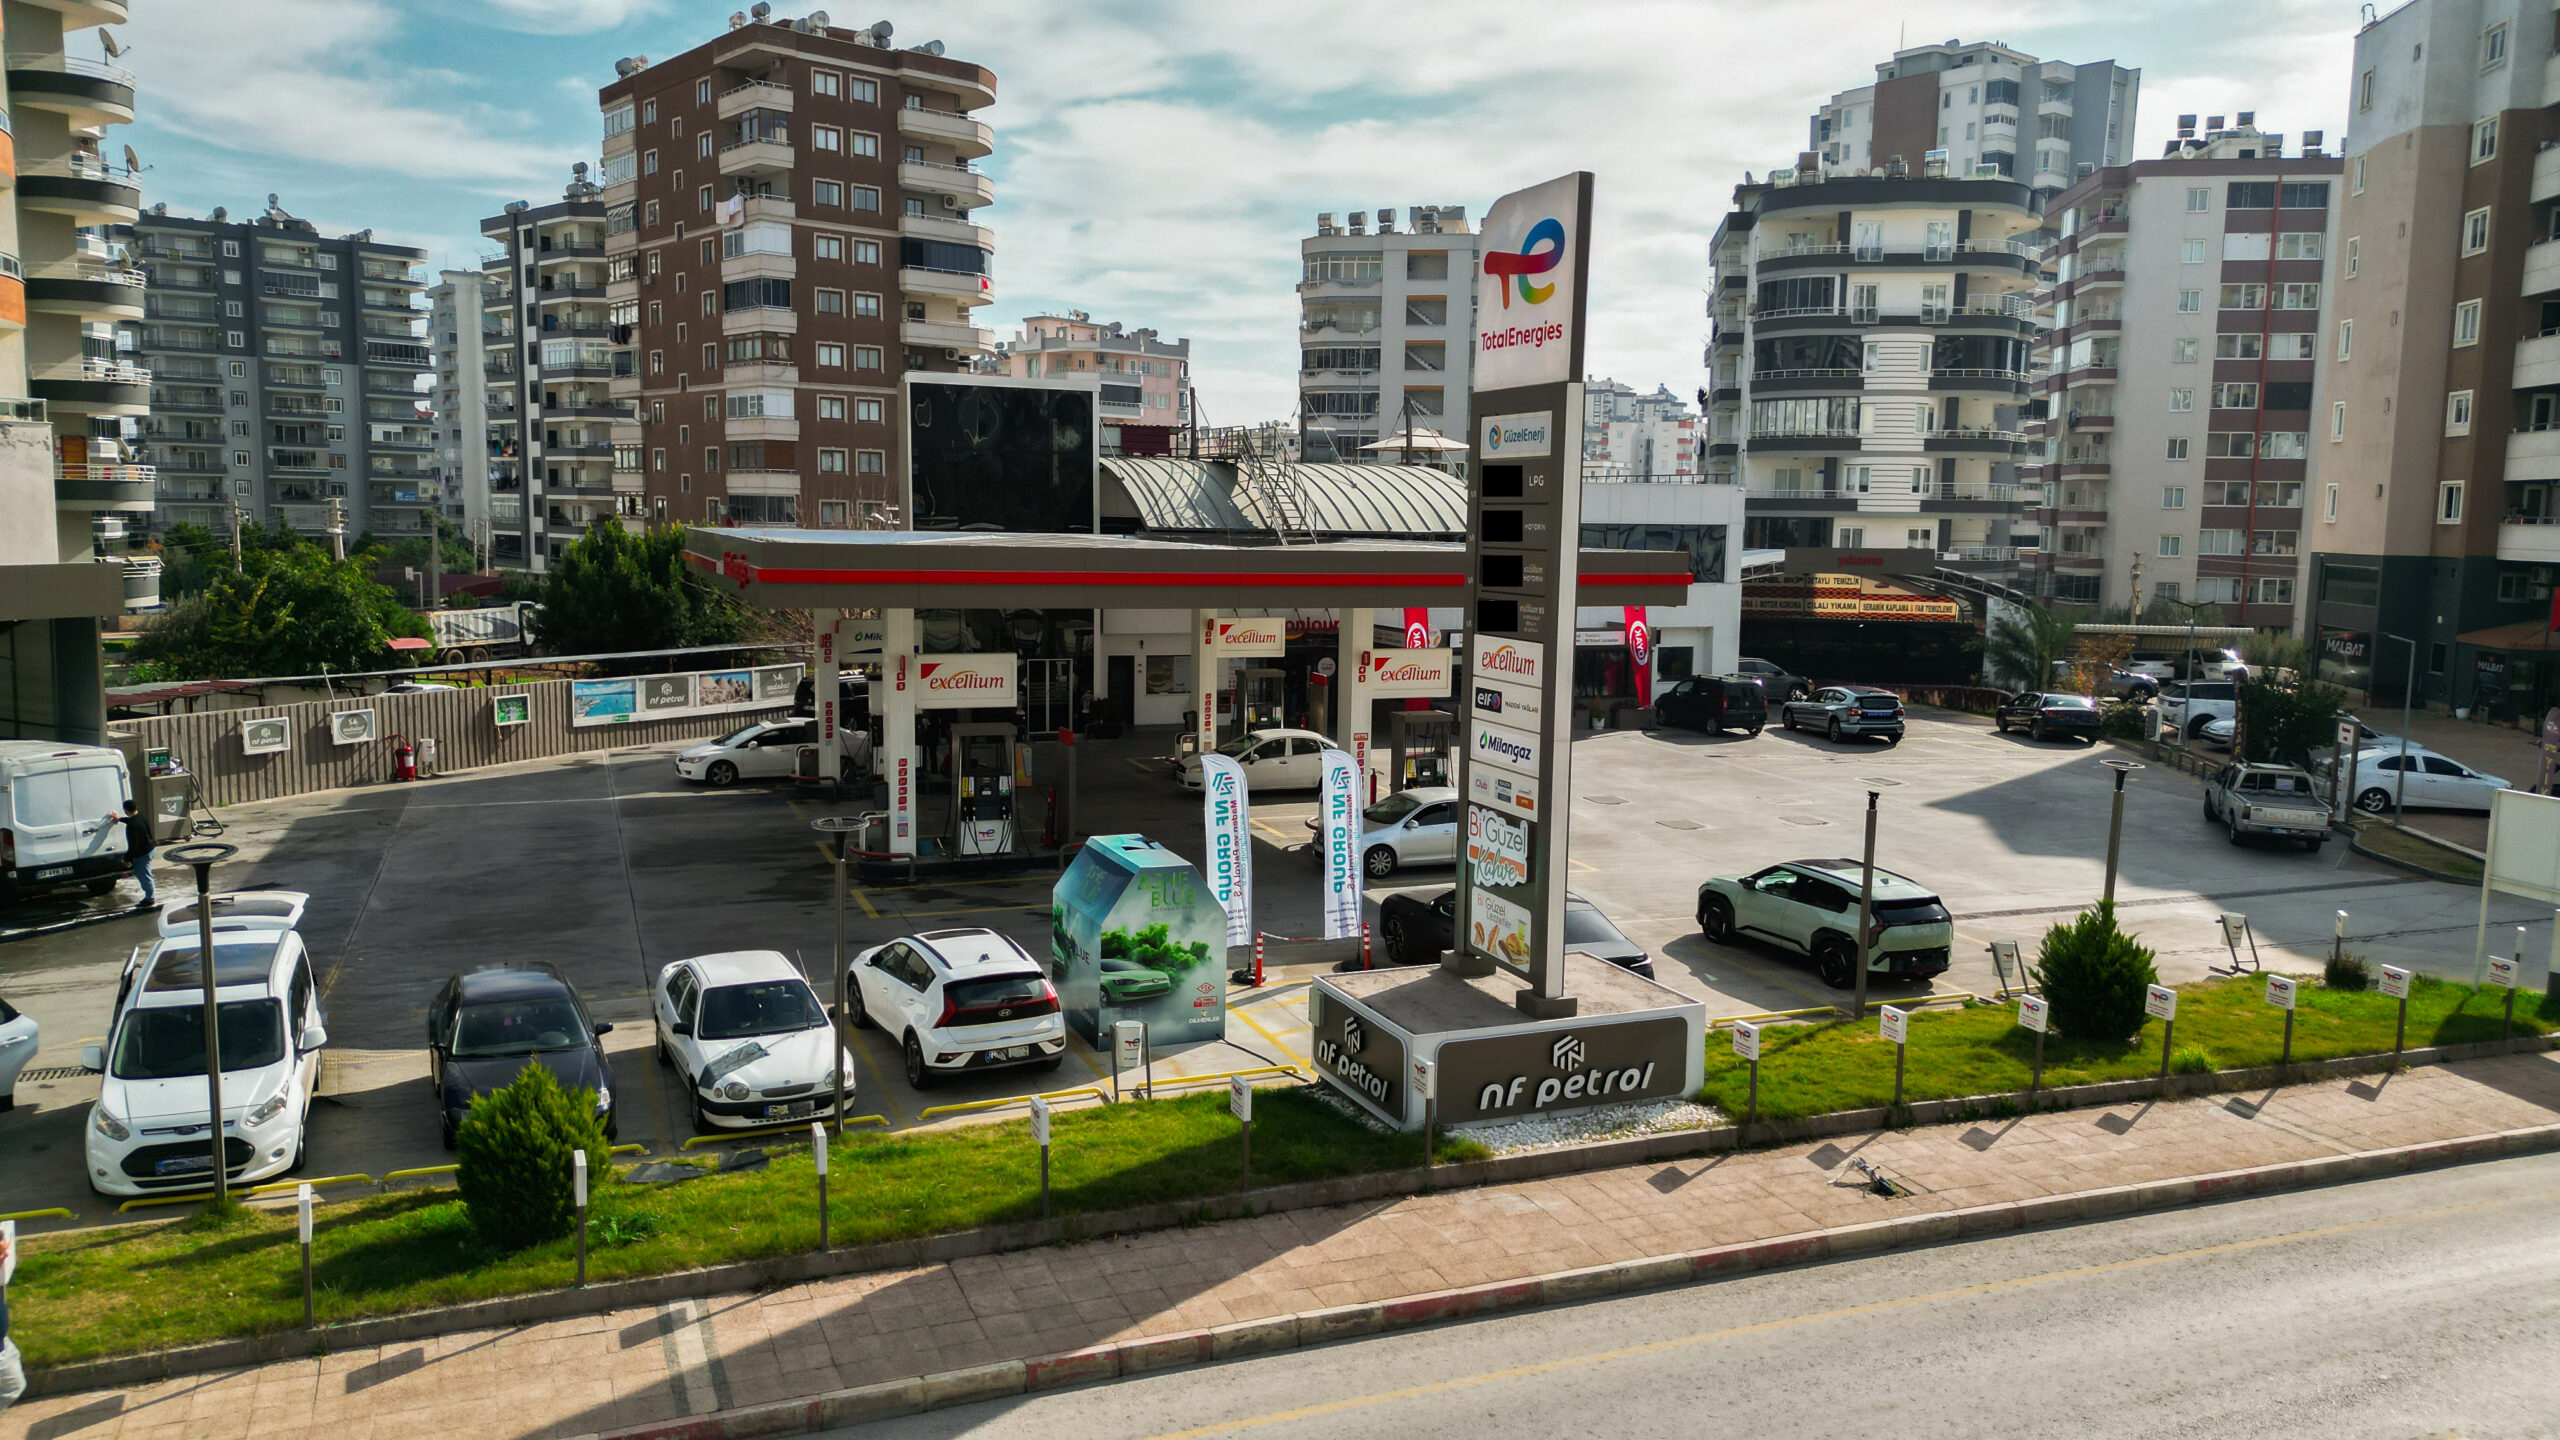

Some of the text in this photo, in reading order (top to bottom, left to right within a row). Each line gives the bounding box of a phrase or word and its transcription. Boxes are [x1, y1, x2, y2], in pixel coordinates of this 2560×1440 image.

[1481, 320, 1563, 352] TotalEnergies
[1503, 427, 1545, 450] GüzelEnerji
[1529, 475, 1544, 487] LPG
[1807, 575, 1859, 585] DETAYLI TEMİZLİK
[1830, 602, 1857, 610] YIKAMA
[1863, 602, 1885, 611] SERAMİK
[1886, 603, 1909, 612] KAPLAMA
[1914, 604, 1924, 612] FAR
[1285, 617, 1339, 634] onjour
[1225, 631, 1276, 645] excellium
[2326, 639, 2365, 656] MALBAT
[1481, 648, 1535, 676] excellium
[2478, 661, 2504, 672] MALBAT
[929, 671, 1004, 691] excellium
[1381, 665, 1441, 682] excellium
[660, 695, 685, 704] petrol
[1477, 692, 1492, 706] elf
[261, 736, 281, 744] petrol
[1488, 735, 1532, 763] Milangaz
[1475, 778, 1488, 790] Club
[1477, 844, 1517, 881] Kahve
[1137, 871, 1191, 891] ASHE
[1152, 887, 1198, 907] BLUE
[1318, 1040, 1337, 1063] nf
[1337, 1054, 1388, 1101] petrol
[1480, 1062, 1655, 1111] nf petrol
